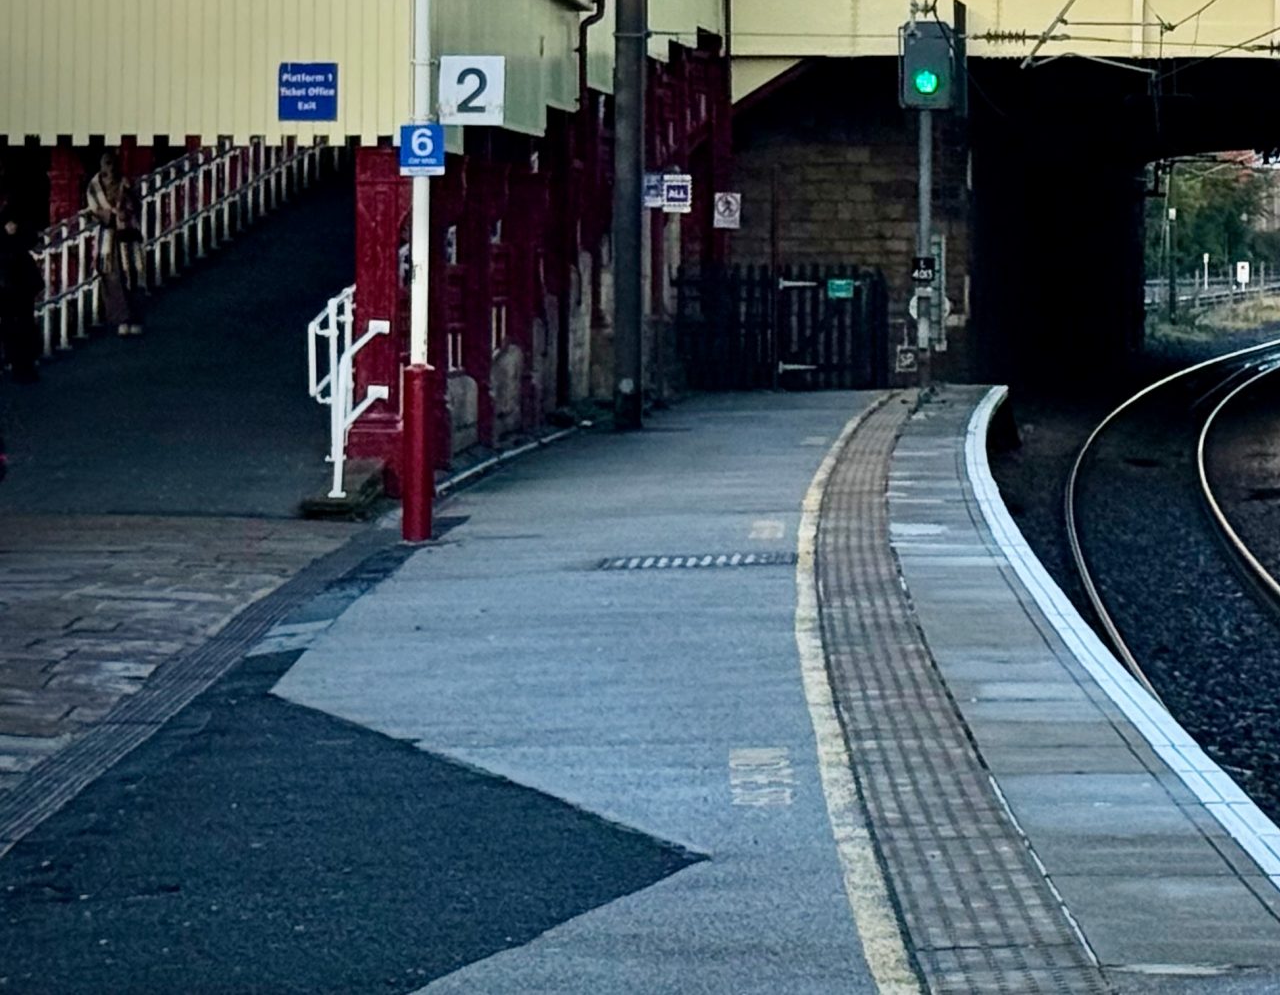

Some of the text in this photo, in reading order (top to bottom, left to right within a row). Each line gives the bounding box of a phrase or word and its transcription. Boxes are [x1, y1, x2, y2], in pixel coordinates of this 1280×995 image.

[282, 73, 333, 82] Platform 1
[280, 87, 335, 96] Ticket Office
[456, 67, 487, 113] 2
[297, 101, 317, 111] Exit
[411, 127, 434, 157] 6
[668, 189, 687, 199] ALL
